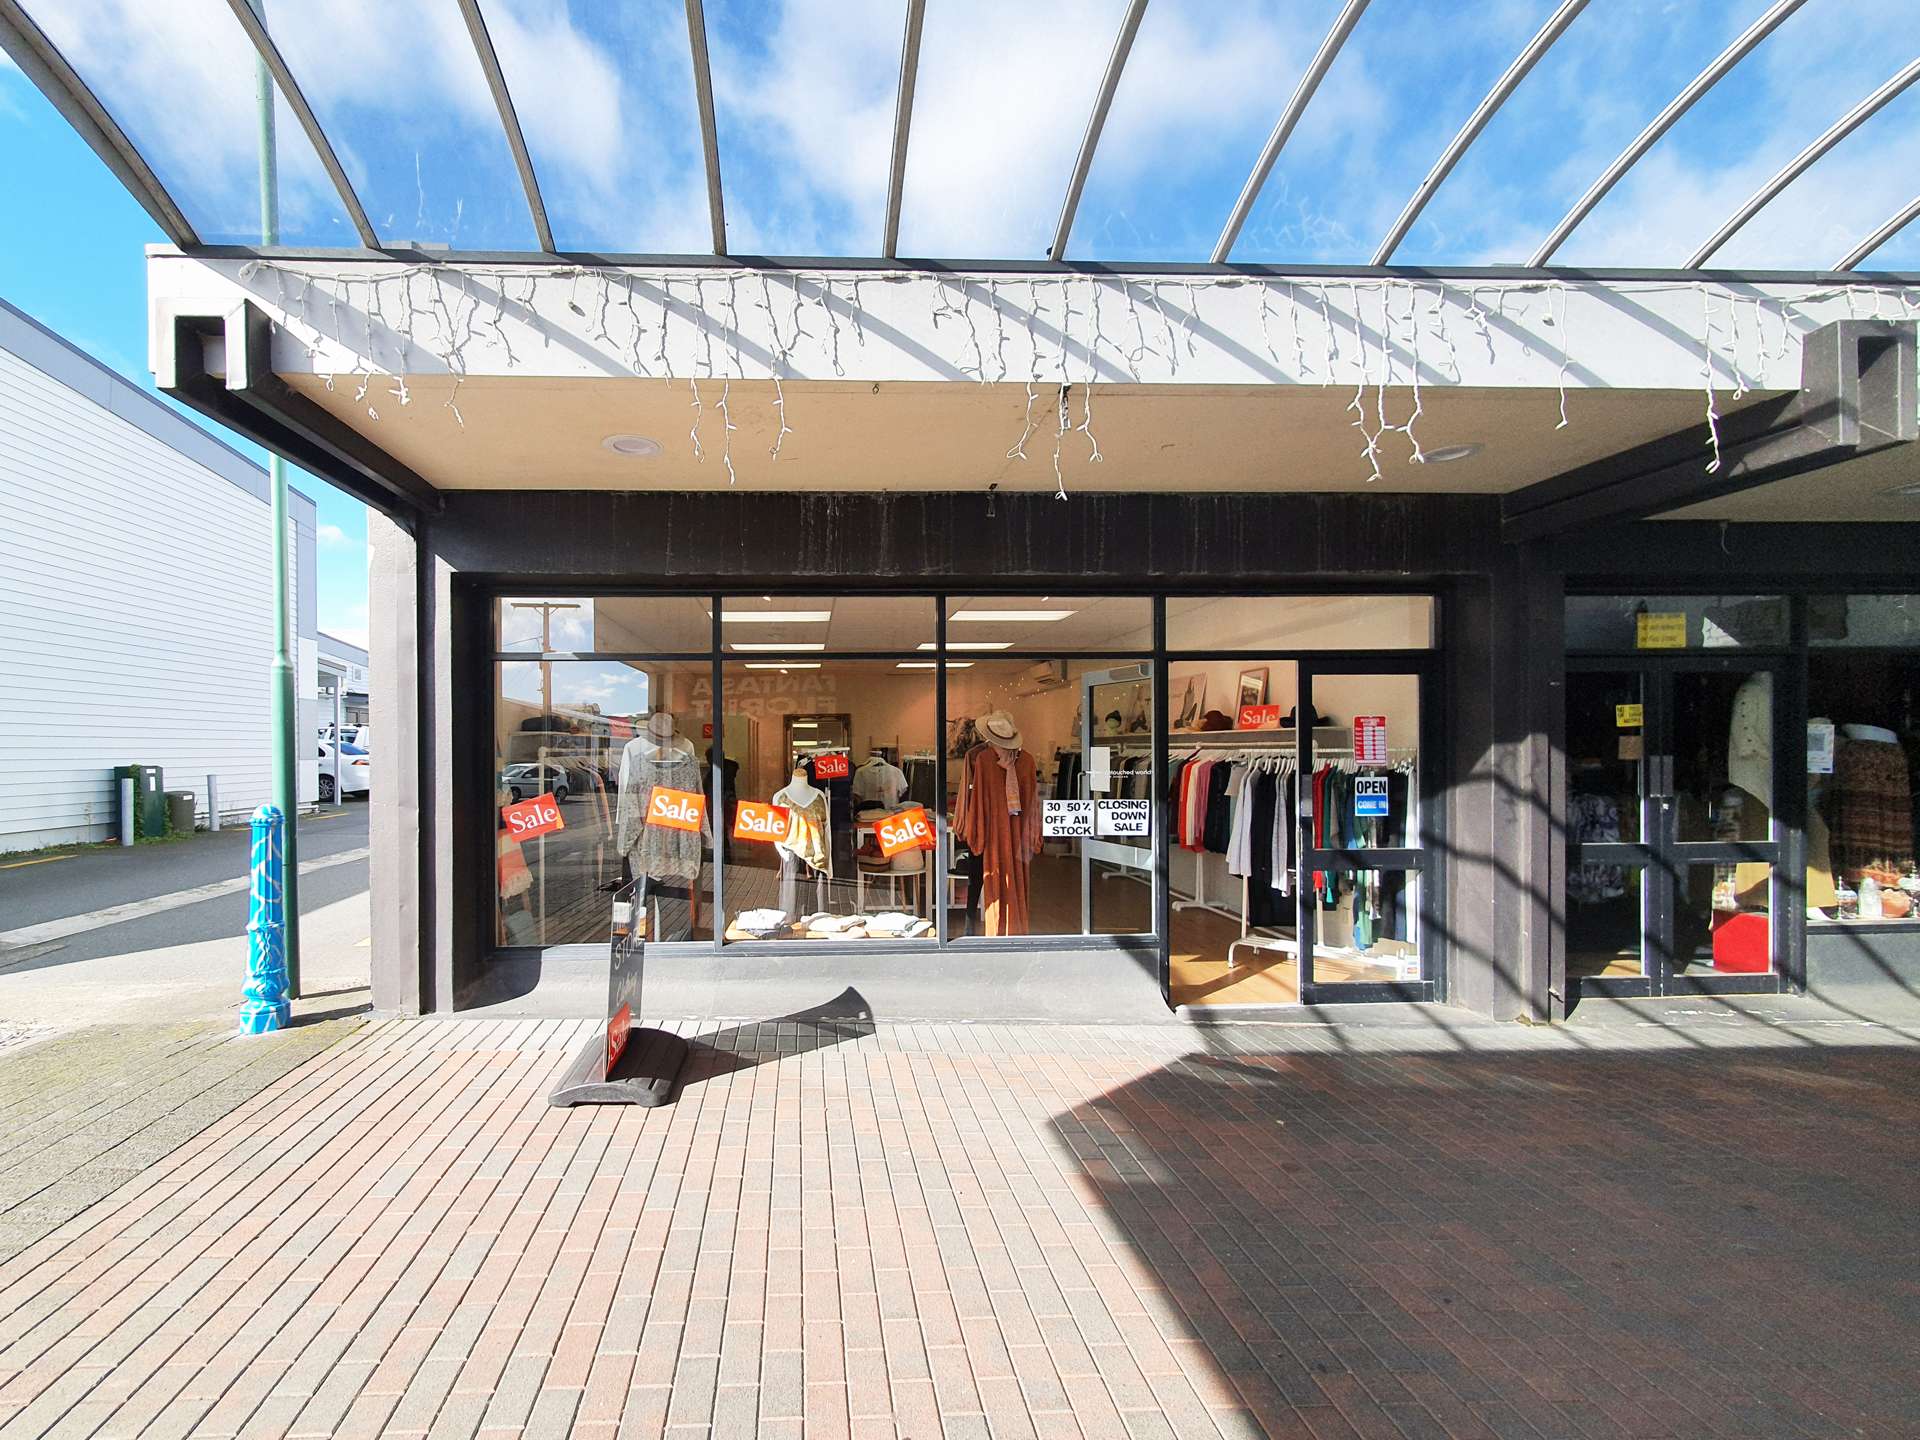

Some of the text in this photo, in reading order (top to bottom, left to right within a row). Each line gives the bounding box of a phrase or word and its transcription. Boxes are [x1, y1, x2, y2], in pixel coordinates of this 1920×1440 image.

[1242, 710, 1276, 724] Sale
[817, 758, 847, 774] Sale
[1356, 781, 1387, 794] OPEN
[652, 795, 699, 823] Sale
[1047, 802, 1061, 812] 30
[1098, 800, 1147, 810] CLOSING
[509, 803, 558, 834] Sale
[738, 809, 785, 835] Sale
[1045, 815, 1067, 825] OFF
[1111, 812, 1147, 821] DOWN
[880, 818, 928, 848] Sale
[1052, 826, 1092, 836] STOCK
[1114, 822, 1144, 832] SALE
